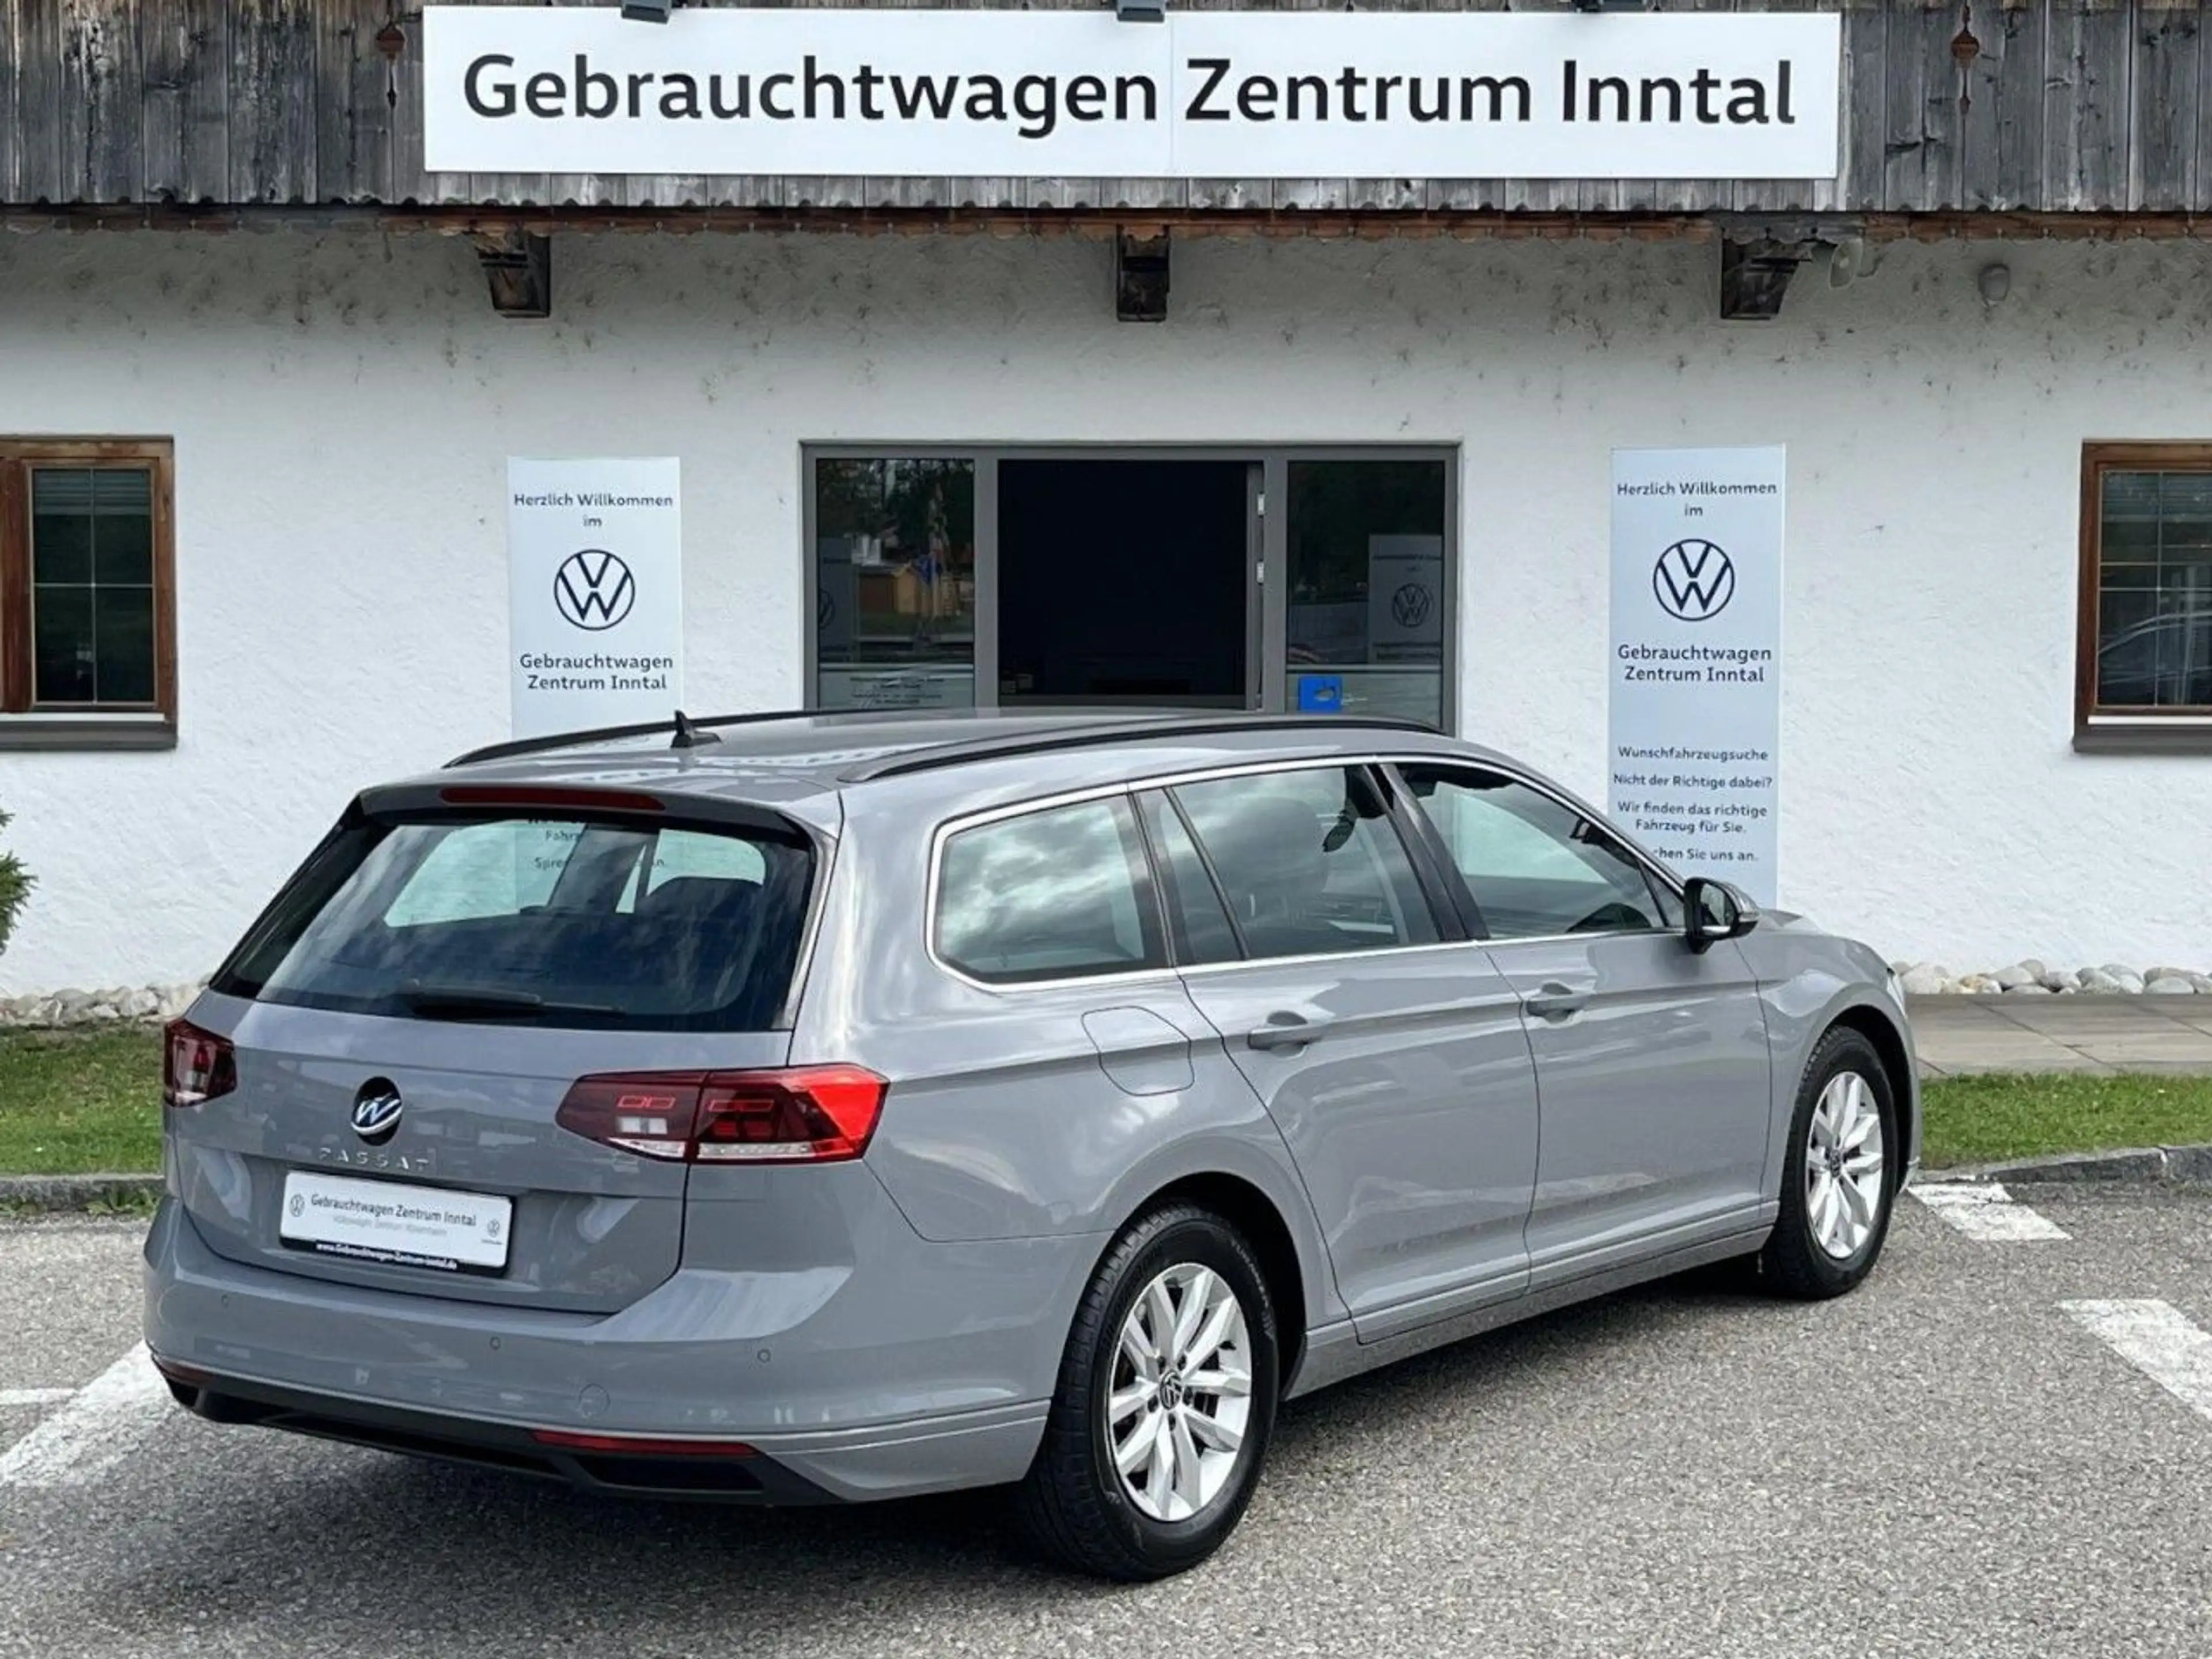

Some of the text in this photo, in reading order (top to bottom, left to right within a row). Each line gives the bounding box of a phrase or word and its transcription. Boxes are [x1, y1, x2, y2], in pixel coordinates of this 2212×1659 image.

[464, 54, 1795, 138] Gebrauchtwagen Zentrum Inntal
[1617, 482, 1777, 495] Herzlich Willkommen
[514, 494, 673, 506] Herzlich Willkommen
[1684, 503, 1703, 516] im
[583, 516, 602, 527] im
[1653, 539, 1735, 621] VW
[554, 549, 635, 631] VW
[520, 653, 673, 672] Gebrauchtwagen
[1618, 645, 1771, 664] Gebrauchtwagen
[528, 673, 667, 690] Zentrum Inntal
[1624, 666, 1764, 683] Zentrum Inntal
[1618, 747, 1768, 763] Wunschfahrzeugsuche
[1614, 774, 1772, 790] Nicht der Richtige dabei?
[1618, 802, 1767, 819] Wir finden das richtige
[1636, 819, 1746, 833] Fahrzeug für Sie.
[1687, 849, 1707, 859] Sie
[1710, 852, 1733, 861] uns
[319, 1147, 429, 1172] PASSAT
[311, 1194, 476, 1226] Gebrauchtwagen Zentrum Inntal
